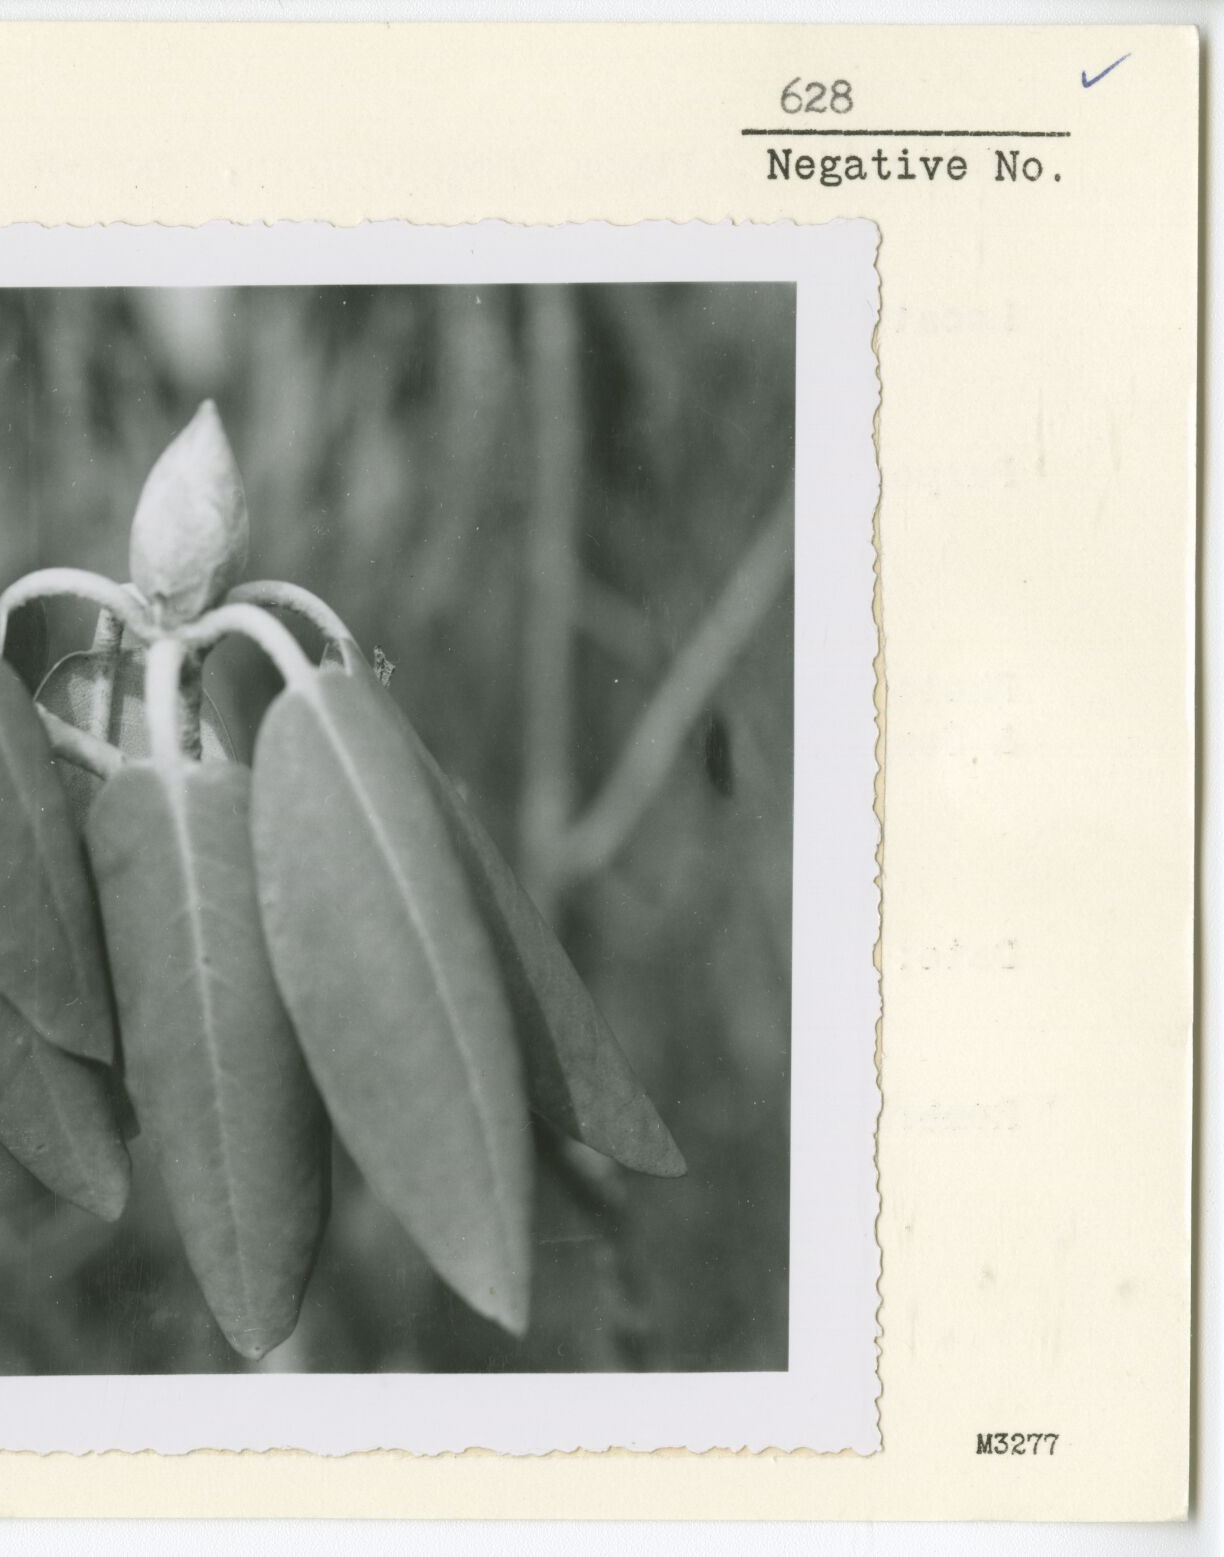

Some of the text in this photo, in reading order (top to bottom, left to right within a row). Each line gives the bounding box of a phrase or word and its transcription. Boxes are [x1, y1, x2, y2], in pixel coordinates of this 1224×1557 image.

[780, 77, 854, 114] 628
[766, 148, 1061, 187] Negative No.
[976, 1432, 1060, 1456] M3277
